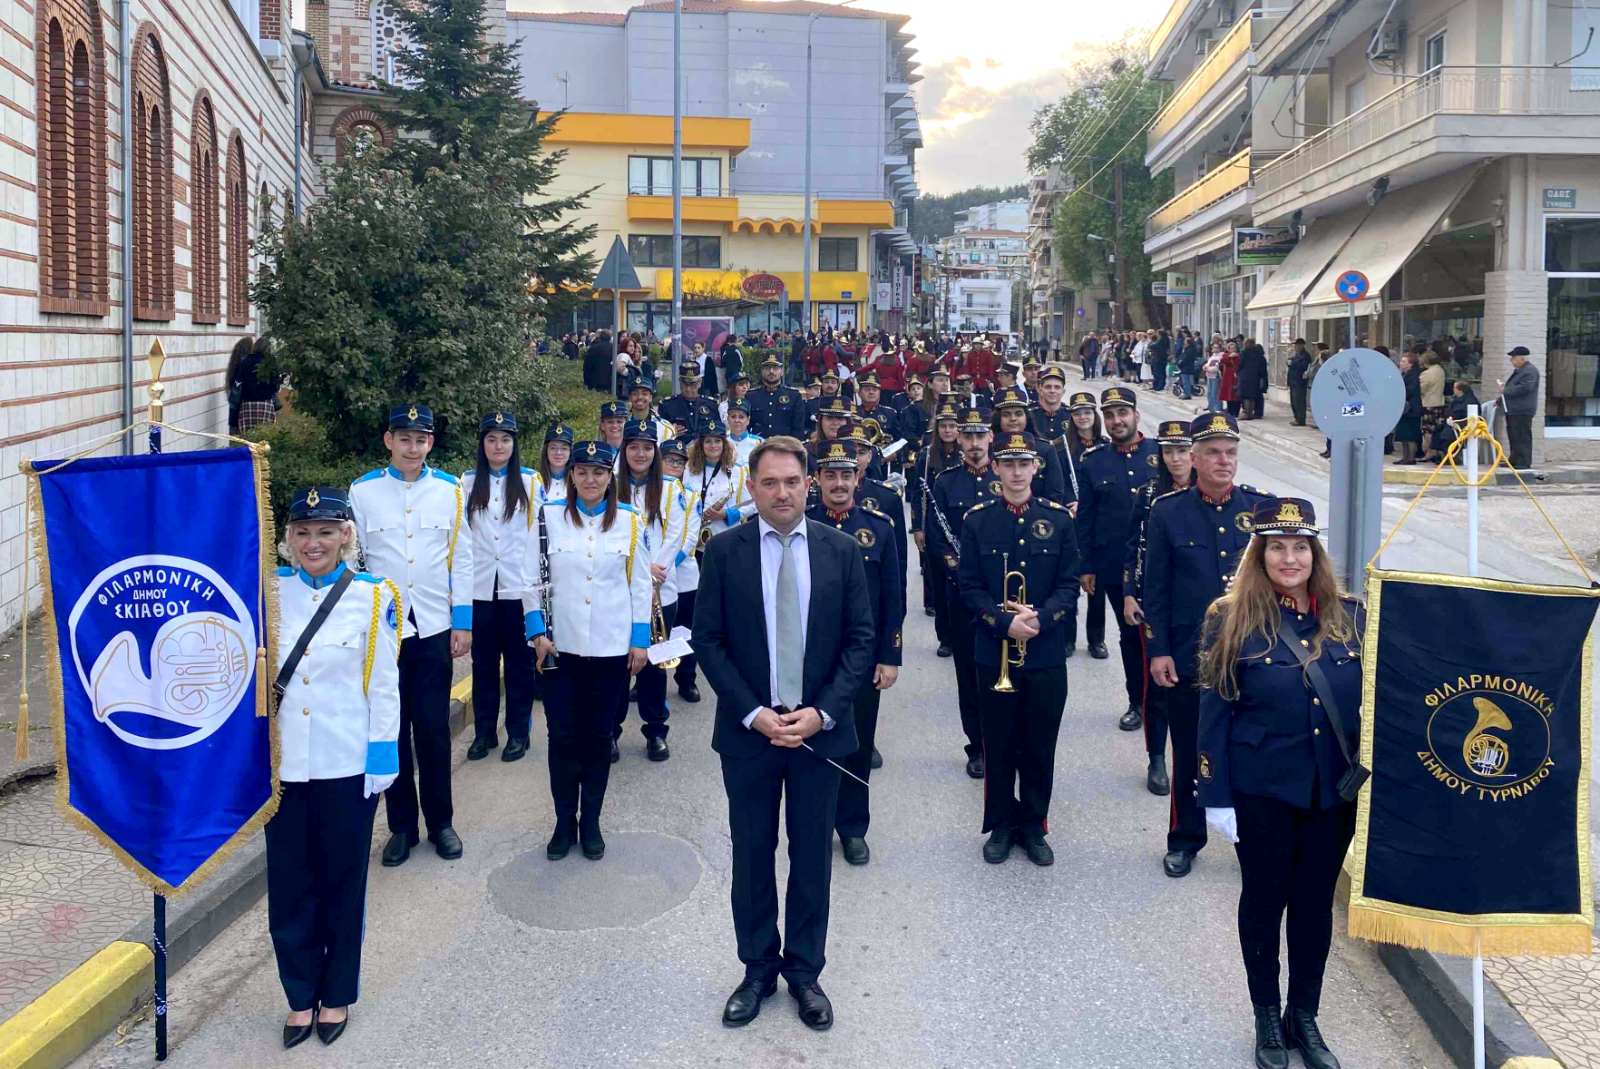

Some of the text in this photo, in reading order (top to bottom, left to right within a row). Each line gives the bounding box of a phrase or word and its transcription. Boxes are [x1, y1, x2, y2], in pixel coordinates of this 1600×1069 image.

[98, 569, 216, 606] ΦΙΛΑΡΜΟΝΙΚΗ
[132, 588, 168, 600] ΔΗΜΟΥ
[114, 600, 191, 619] ΣΚΙΑΘΟΥ
[1424, 674, 1556, 718] ΦΙΛΑΡΜΟΝΙΚΗ
[1416, 751, 1556, 802] ΔΗΜΟΥ ΤΥΡΝΑΒΟΥ
